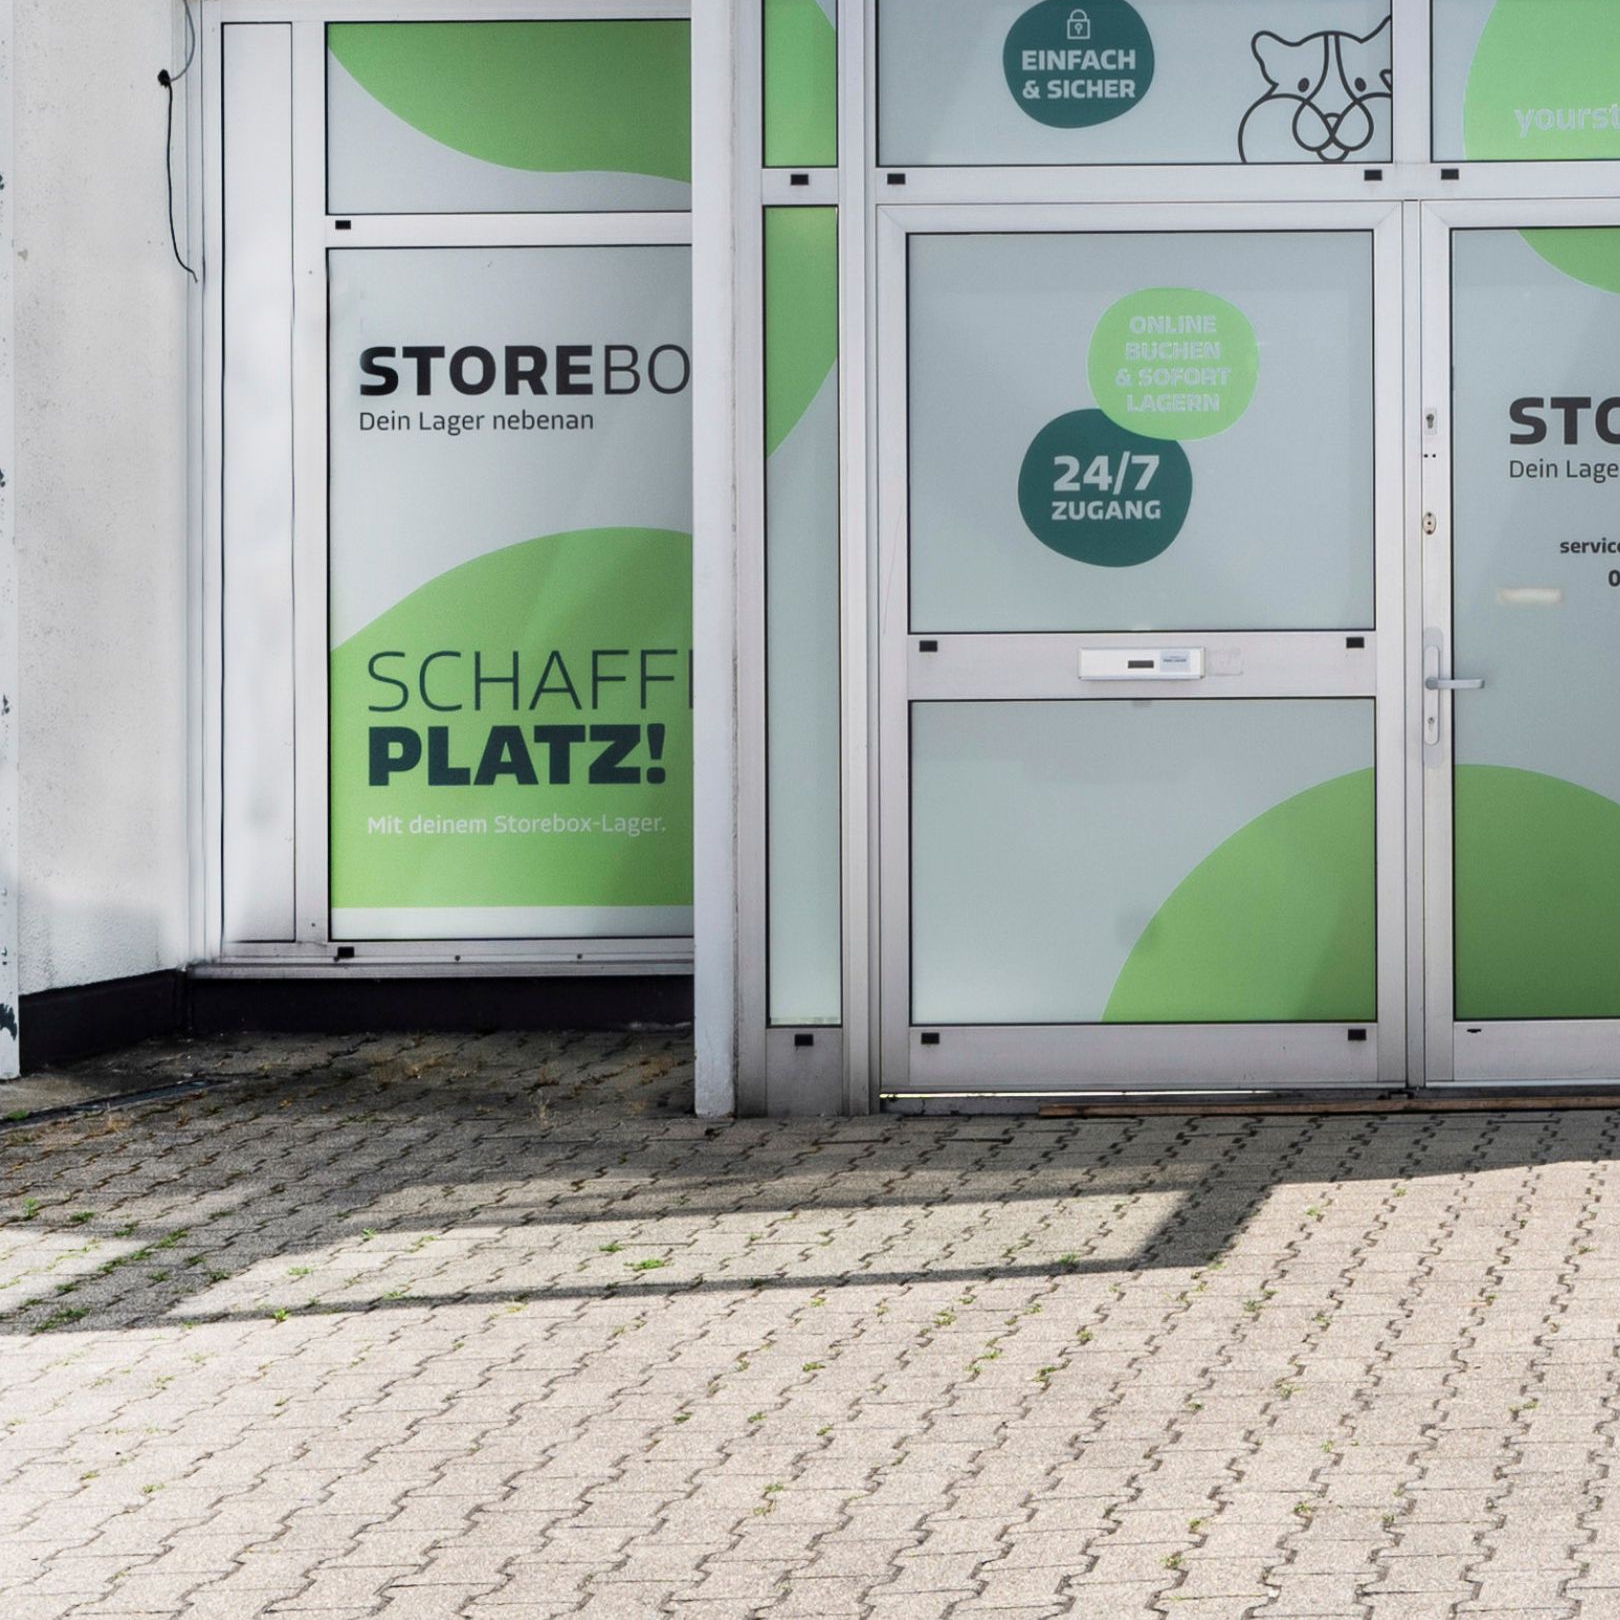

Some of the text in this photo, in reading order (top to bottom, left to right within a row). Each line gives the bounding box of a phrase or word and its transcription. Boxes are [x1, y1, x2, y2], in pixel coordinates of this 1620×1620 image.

[1022, 49, 1136, 71] EINFACH
[1022, 79, 1136, 99] & SICHER
[1129, 315, 1217, 334] ONLINE
[1125, 342, 1221, 360] BUCHEN
[1115, 367, 1232, 387] & SOFORT
[1126, 394, 1220, 413] LAGERN
[359, 409, 594, 436] Dein Lager nebenan
[1053, 451, 1160, 495] 24/7
[1509, 458, 1558, 479] Dein
[1051, 500, 1161, 520] ZUGANG
[367, 649, 693, 712] SCHAFF
[368, 723, 666, 786] PLATZ!
[367, 812, 666, 837] Mit deinem Storebox-Lager.
